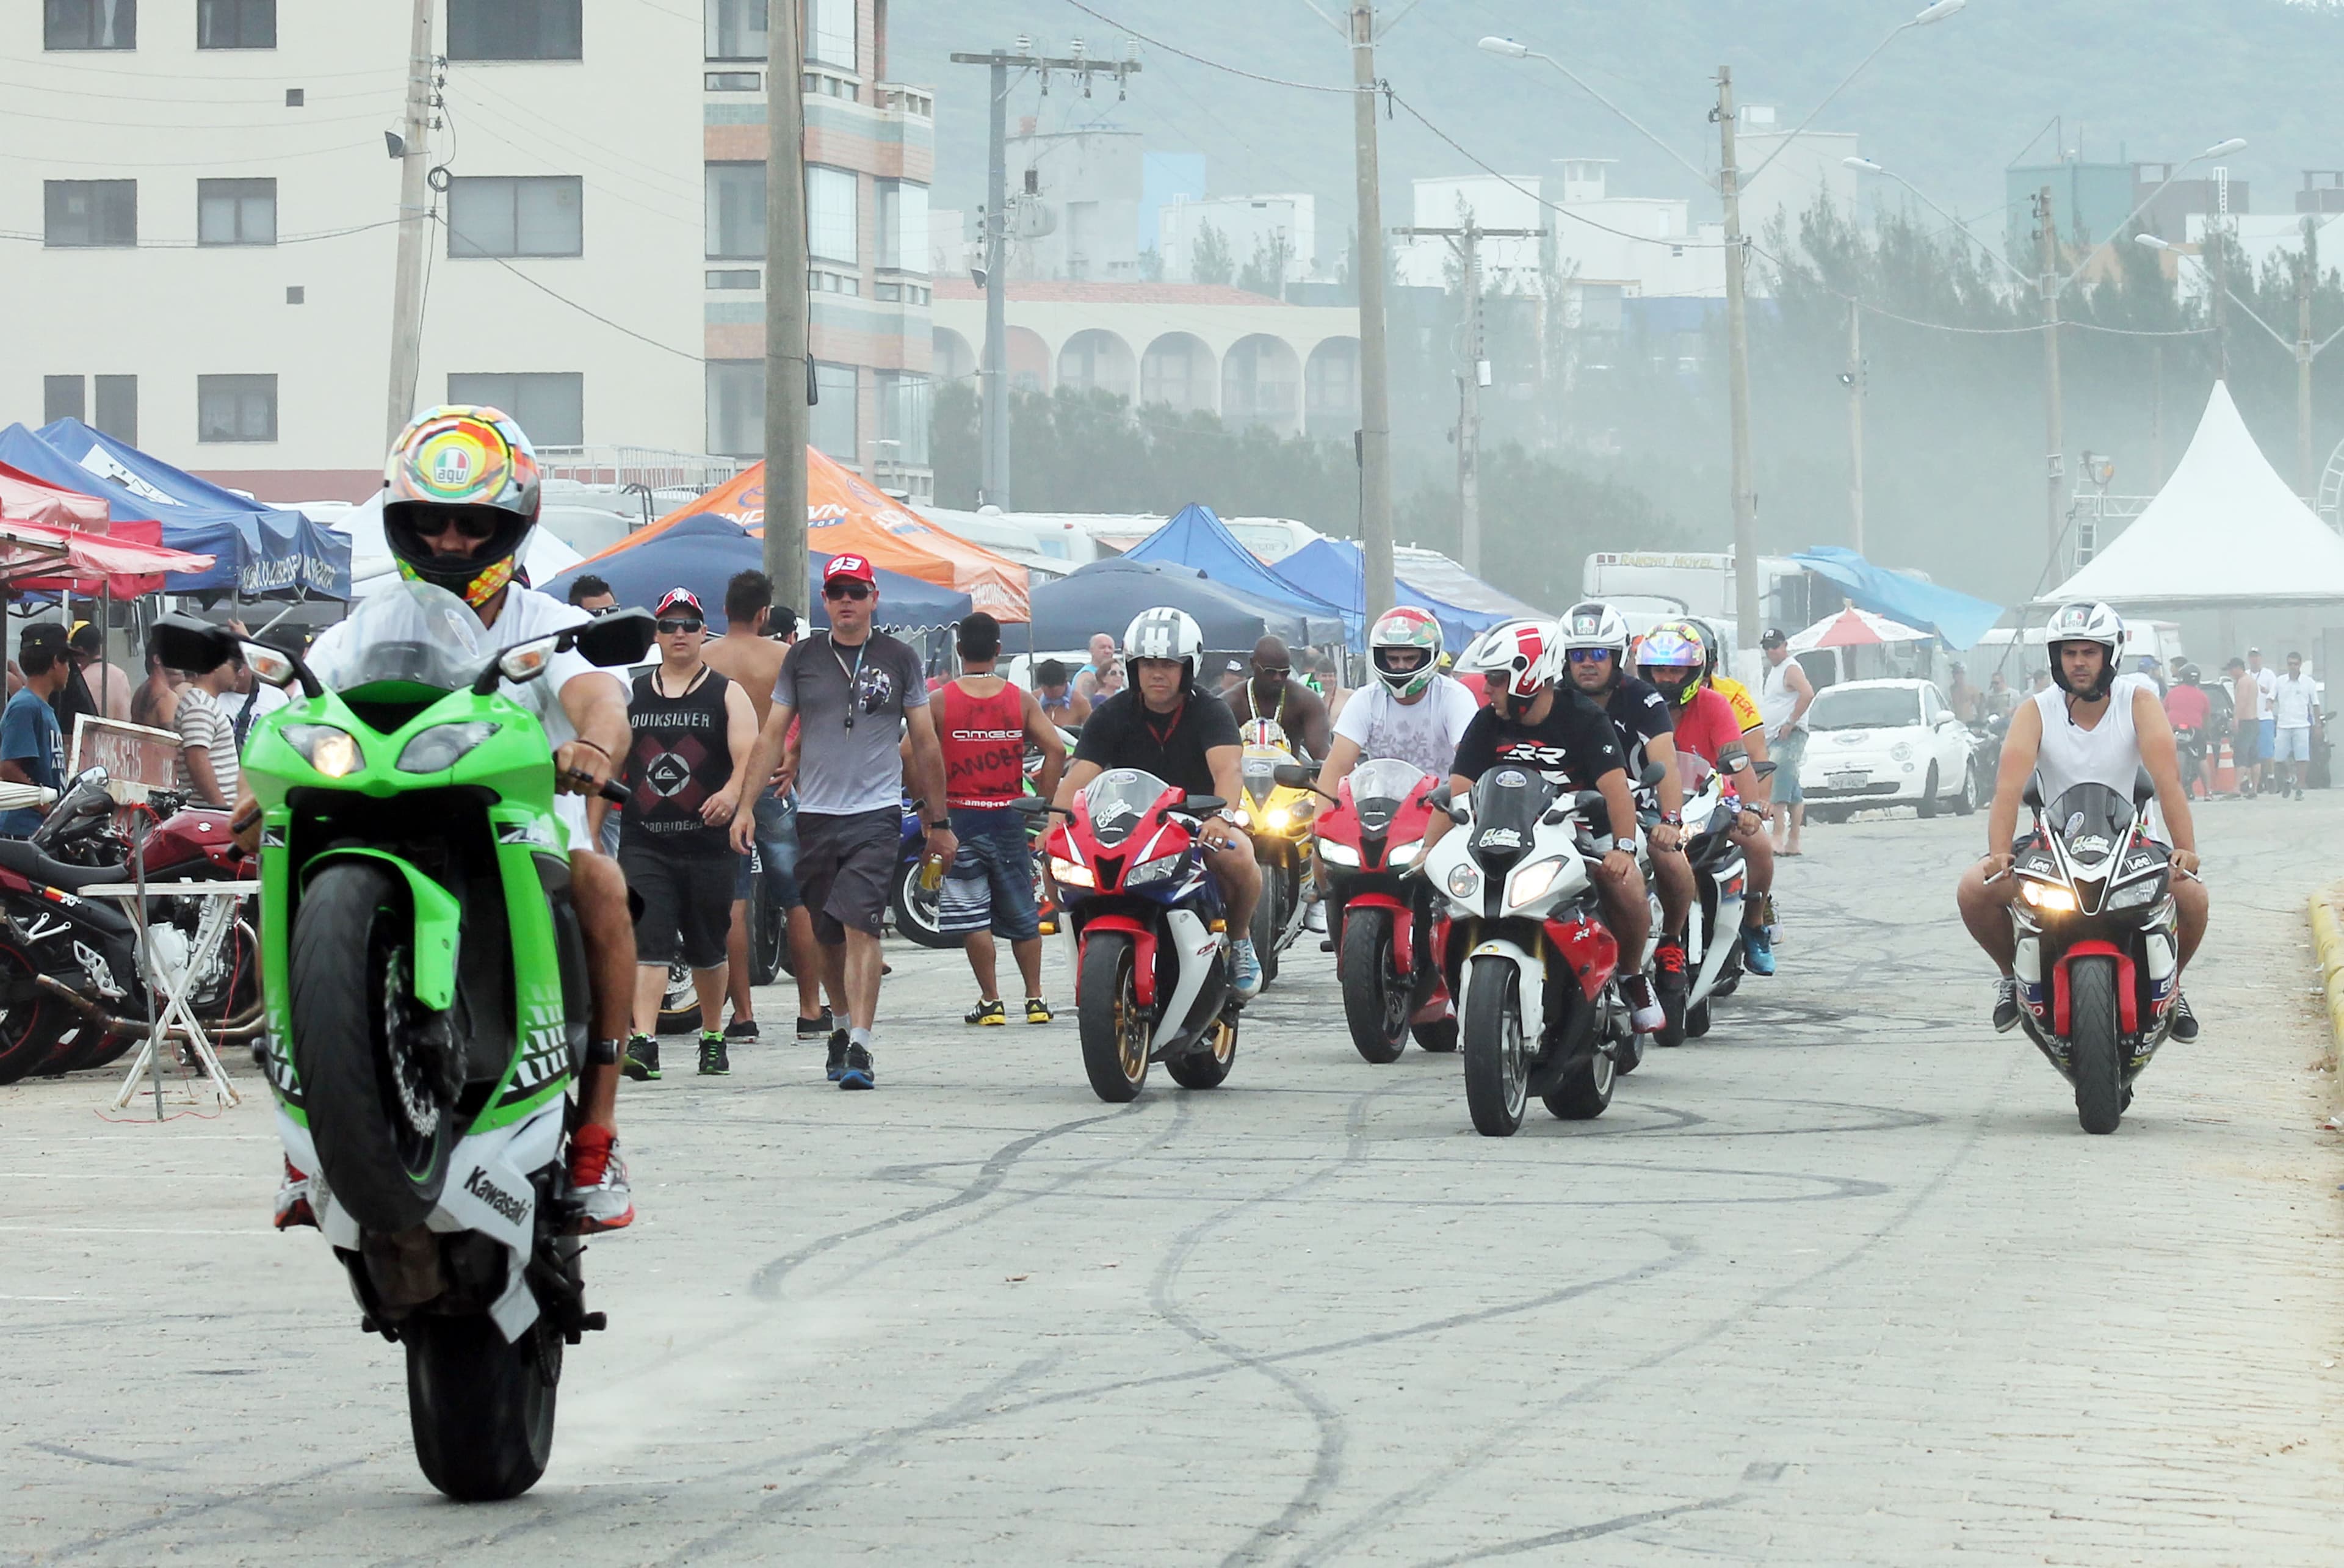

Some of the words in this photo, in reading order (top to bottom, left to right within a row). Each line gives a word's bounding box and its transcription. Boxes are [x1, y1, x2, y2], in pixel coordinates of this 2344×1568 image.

[827, 557, 863, 576] 93
[631, 712, 710, 728] QUIKSILVER
[2028, 858, 2050, 872] Lee
[2128, 856, 2150, 870] Lee
[463, 1165, 533, 1227] Kawasaki
